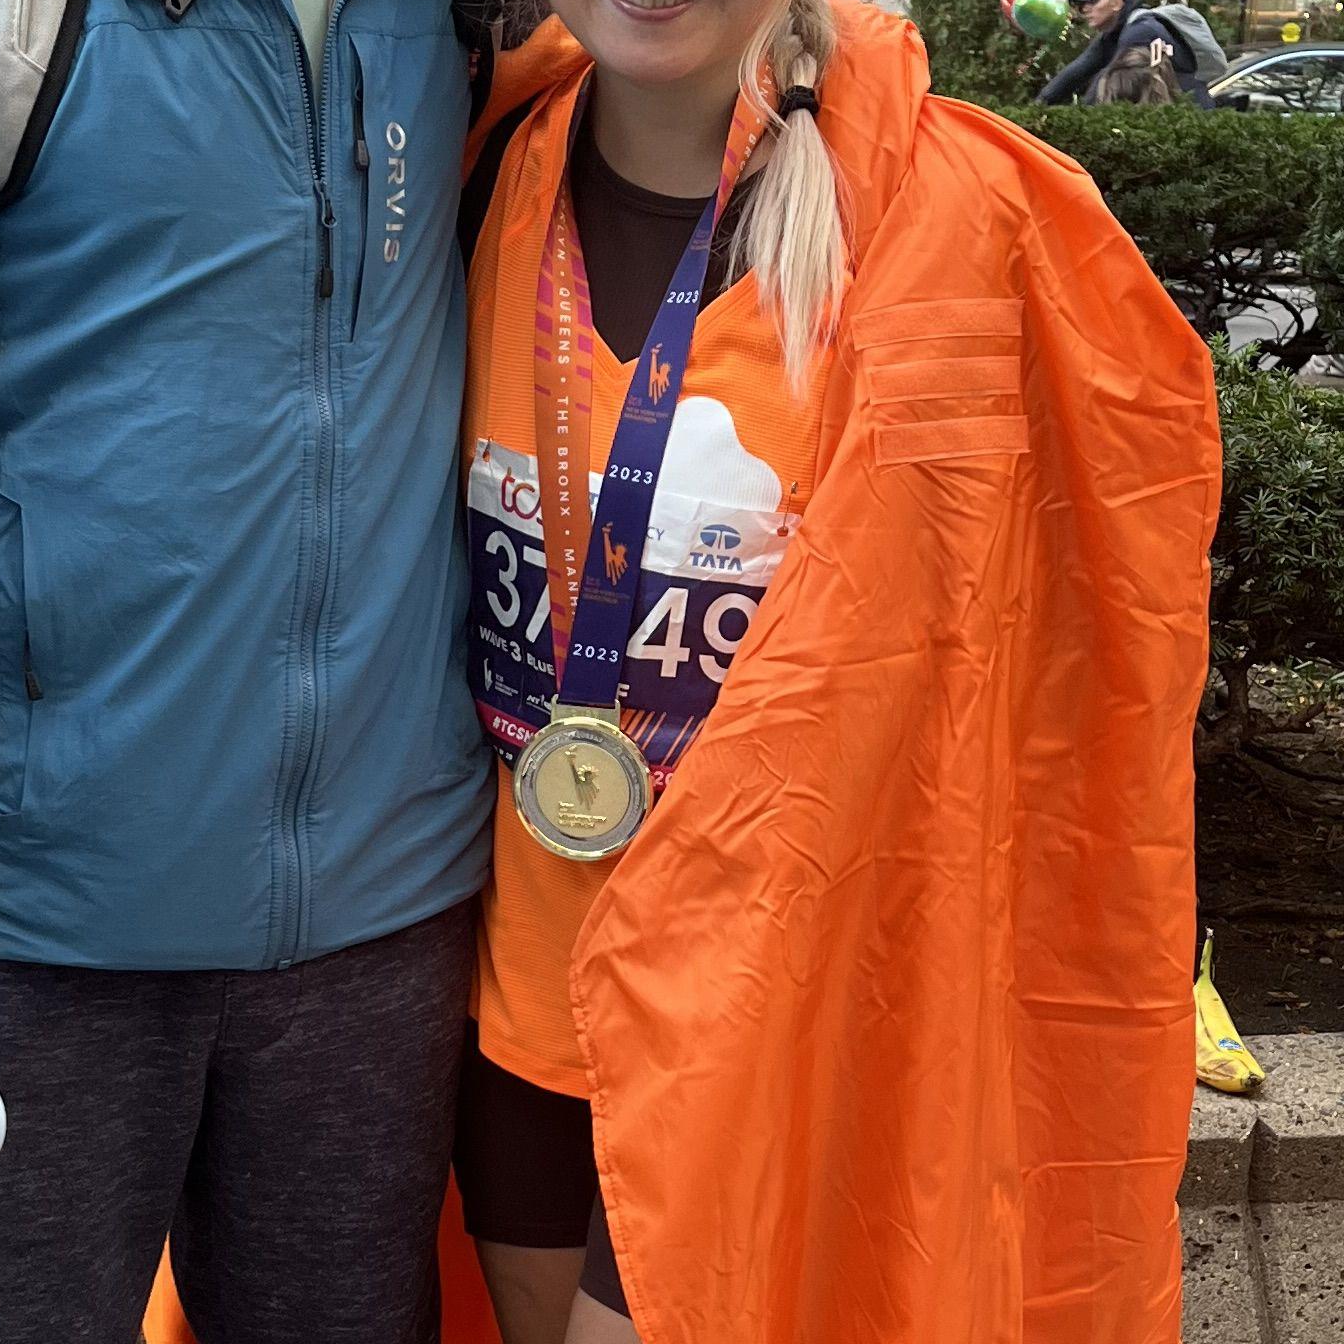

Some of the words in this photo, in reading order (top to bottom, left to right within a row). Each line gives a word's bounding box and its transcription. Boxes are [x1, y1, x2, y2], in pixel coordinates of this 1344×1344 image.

[384, 121, 407, 264] ORVIS
[666, 290, 700, 305] 2023
[556, 287, 571, 366] QUEENS
[557, 396, 569, 434] THE
[557, 447, 571, 516] BRONX
[608, 464, 654, 485] 2023
[689, 552, 743, 572] TATA
[479, 625, 509, 652] WAVE
[510, 640, 523, 663] 3
[527, 652, 556, 676] BLUE
[572, 643, 619, 664] 2023
